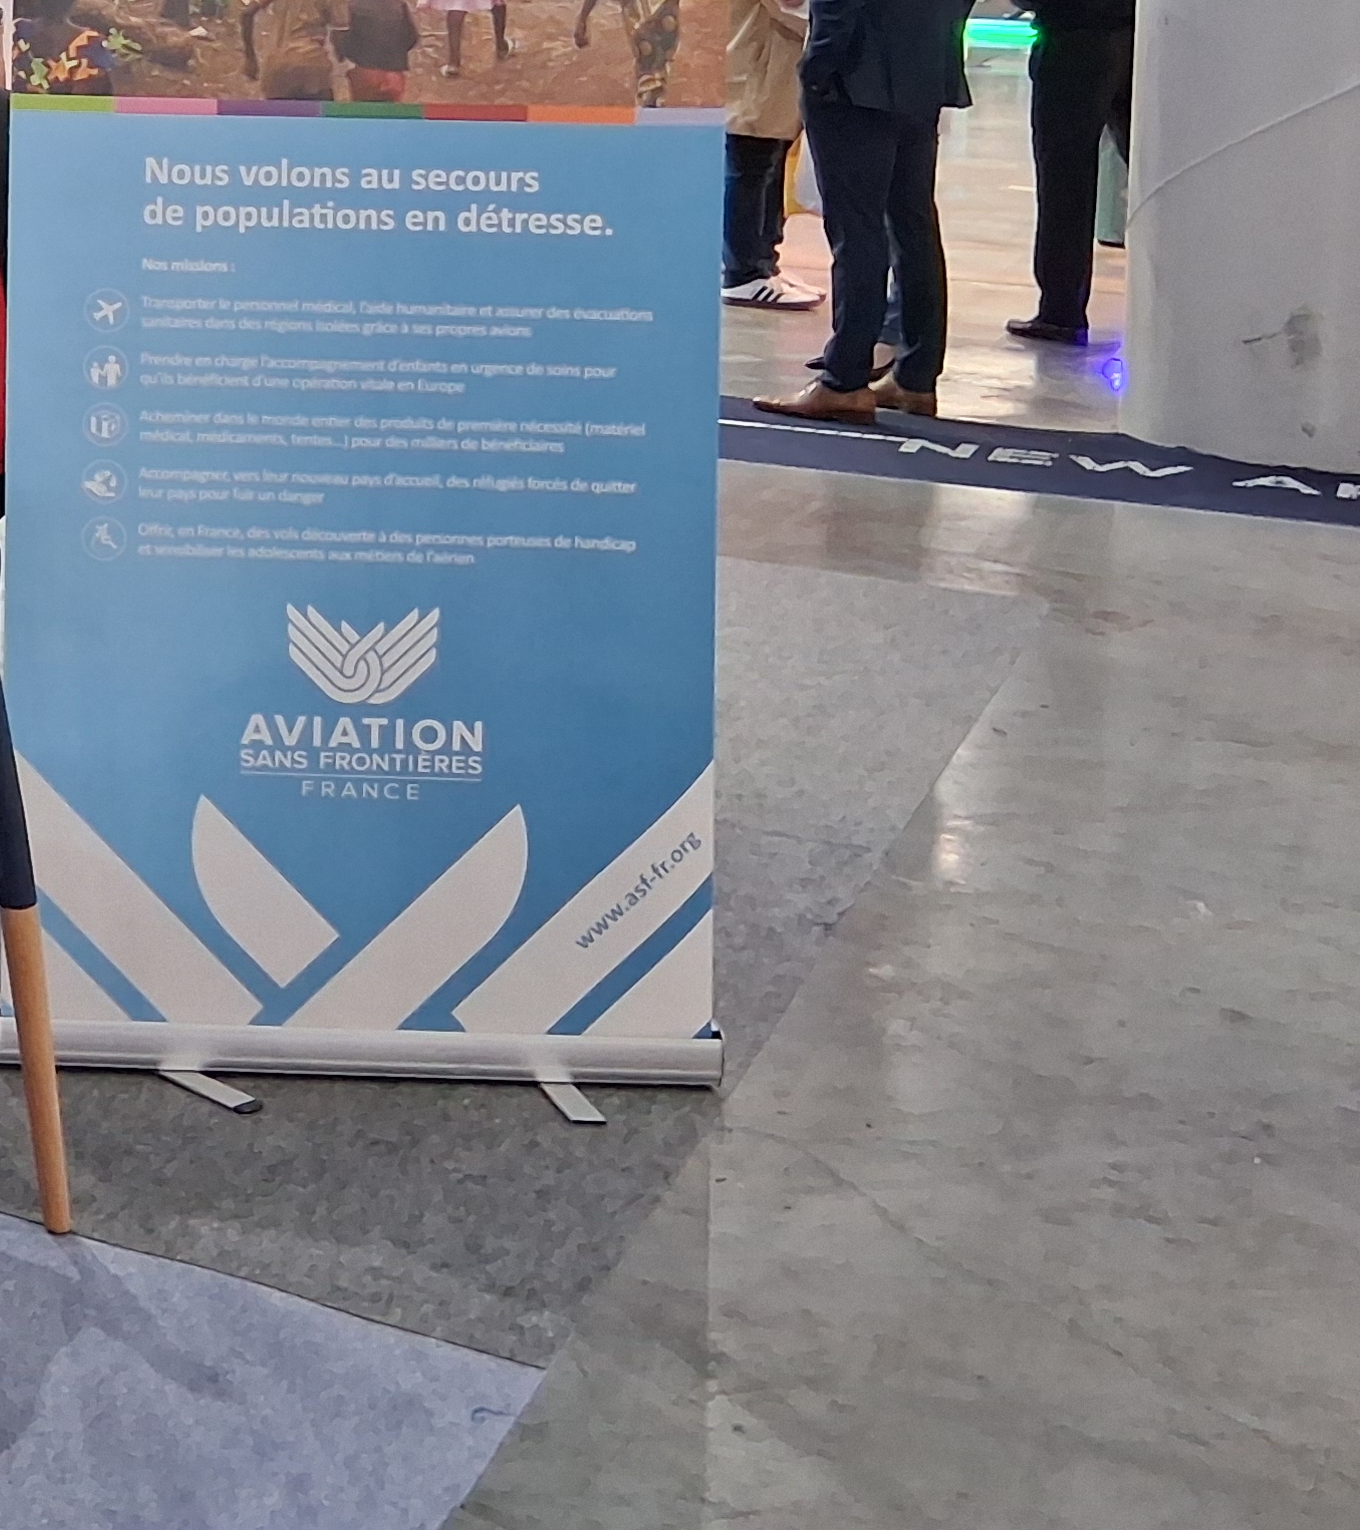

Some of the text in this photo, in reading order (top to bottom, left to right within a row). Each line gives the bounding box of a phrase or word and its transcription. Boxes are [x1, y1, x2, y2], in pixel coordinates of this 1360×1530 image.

[144, 157, 540, 194] Nous volons au secours
[143, 197, 614, 238] de populations en détresse.
[142, 259, 228, 273] Nos missions
[899, 438, 1193, 477] NEW
[167, 488, 325, 505] pays pour un danger
[240, 714, 484, 752] AVIATION
[240, 748, 483, 774] SANS FRONTIÈRES
[301, 780, 419, 801] FRANCE
[575, 830, 704, 949] www.asf-fr.org
